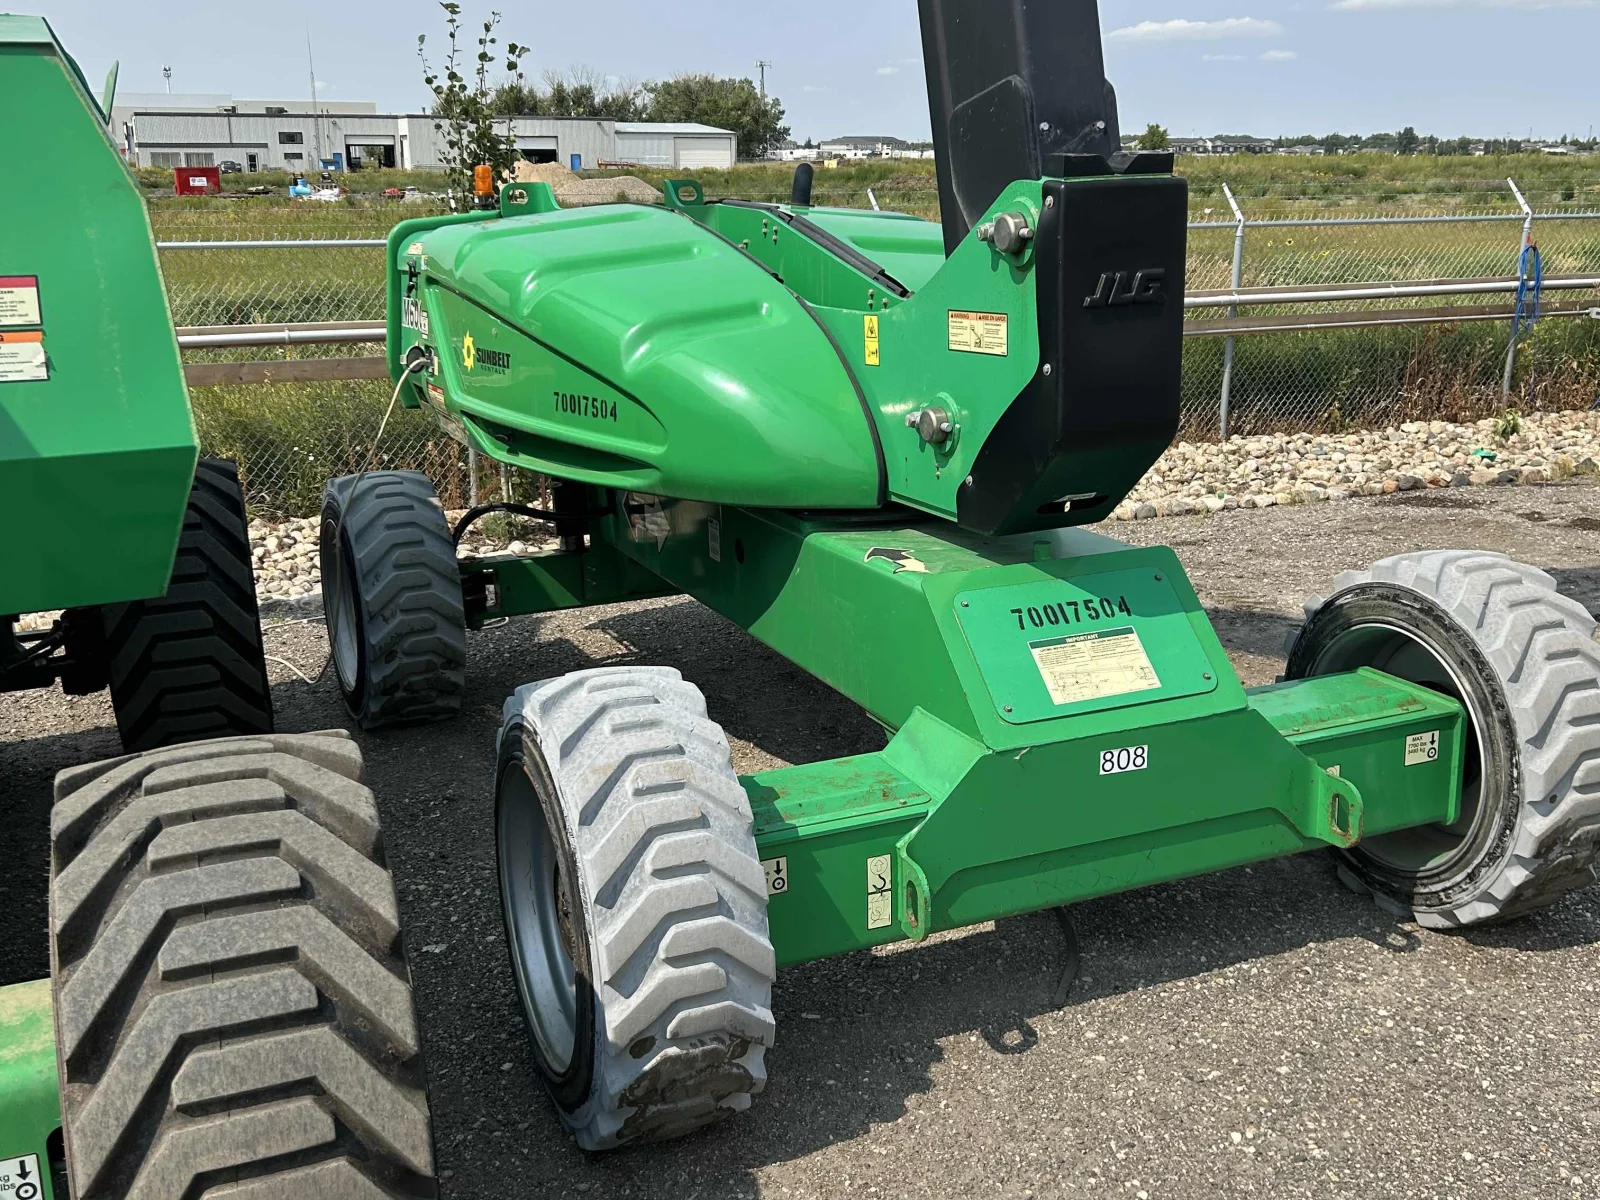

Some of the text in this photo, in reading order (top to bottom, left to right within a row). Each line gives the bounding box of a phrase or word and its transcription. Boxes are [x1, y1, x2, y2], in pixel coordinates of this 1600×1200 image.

[1083, 268, 1165, 307] JLG
[476, 347, 511, 369] SUNBELT
[480, 364, 506, 375] RENTALS
[553, 391, 617, 422] 70017504
[1010, 595, 1132, 631] 70017504
[1066, 633, 1099, 643] IMPORTANT
[1101, 746, 1146, 773] 808
